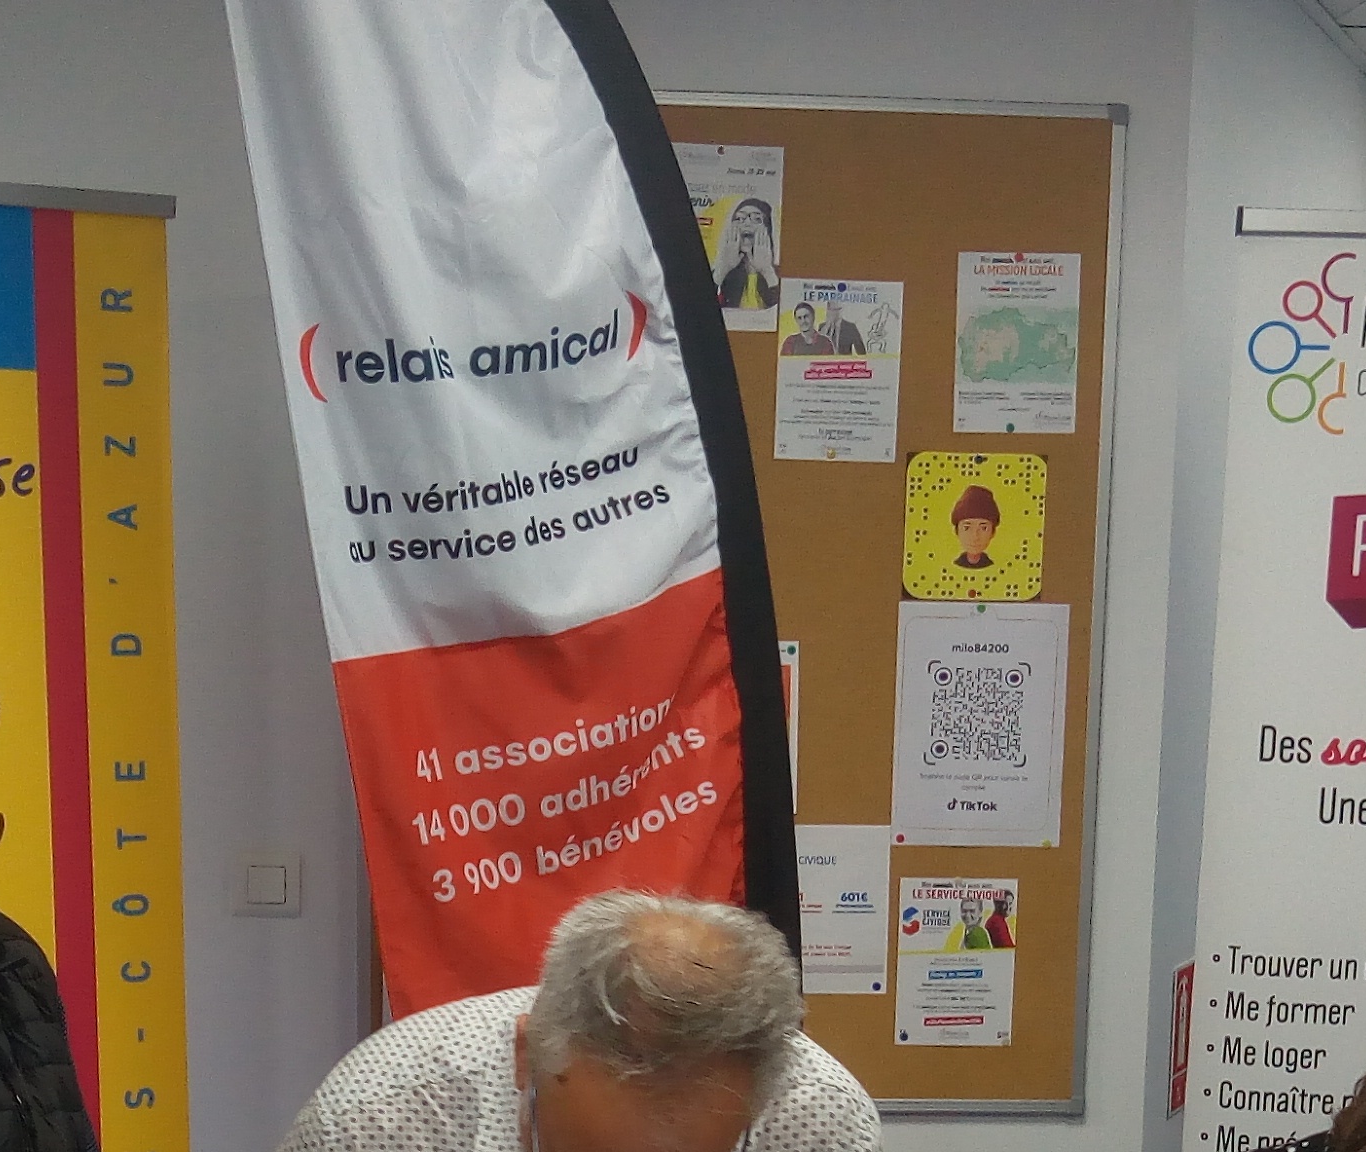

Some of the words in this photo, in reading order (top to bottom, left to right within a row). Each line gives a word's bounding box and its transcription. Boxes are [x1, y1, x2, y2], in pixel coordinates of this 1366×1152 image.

[987, 265, 1027, 276] MISSION
[469, 307, 620, 378] amical
[100, 287, 143, 658] D'AZUR
[343, 484, 393, 515] Un
[400, 468, 536, 515] véritable
[538, 445, 639, 494] réseau
[348, 538, 377, 564] au
[387, 528, 517, 563] service
[524, 514, 566, 547] des
[572, 482, 671, 533] autres
[951, 642, 1010, 654] milo84200
[415, 746, 444, 783] 41
[454, 692, 677, 776] association
[1259, 724, 1313, 764] Des
[960, 801, 998, 812] TikTok
[432, 867, 456, 903] 3
[463, 850, 523, 895] 900
[535, 779, 718, 876] bénévoles
[912, 888, 923, 899] LE
[926, 889, 964, 900] SERVICE
[1227, 944, 1323, 979] Trouver
[1329, 957, 1357, 981] un
[1224, 990, 1260, 1022] Me
[1265, 994, 1356, 1028] former
[1221, 1035, 1256, 1066] Me
[1263, 1039, 1327, 1074] loger
[1218, 1080, 1335, 1115] Connaître
